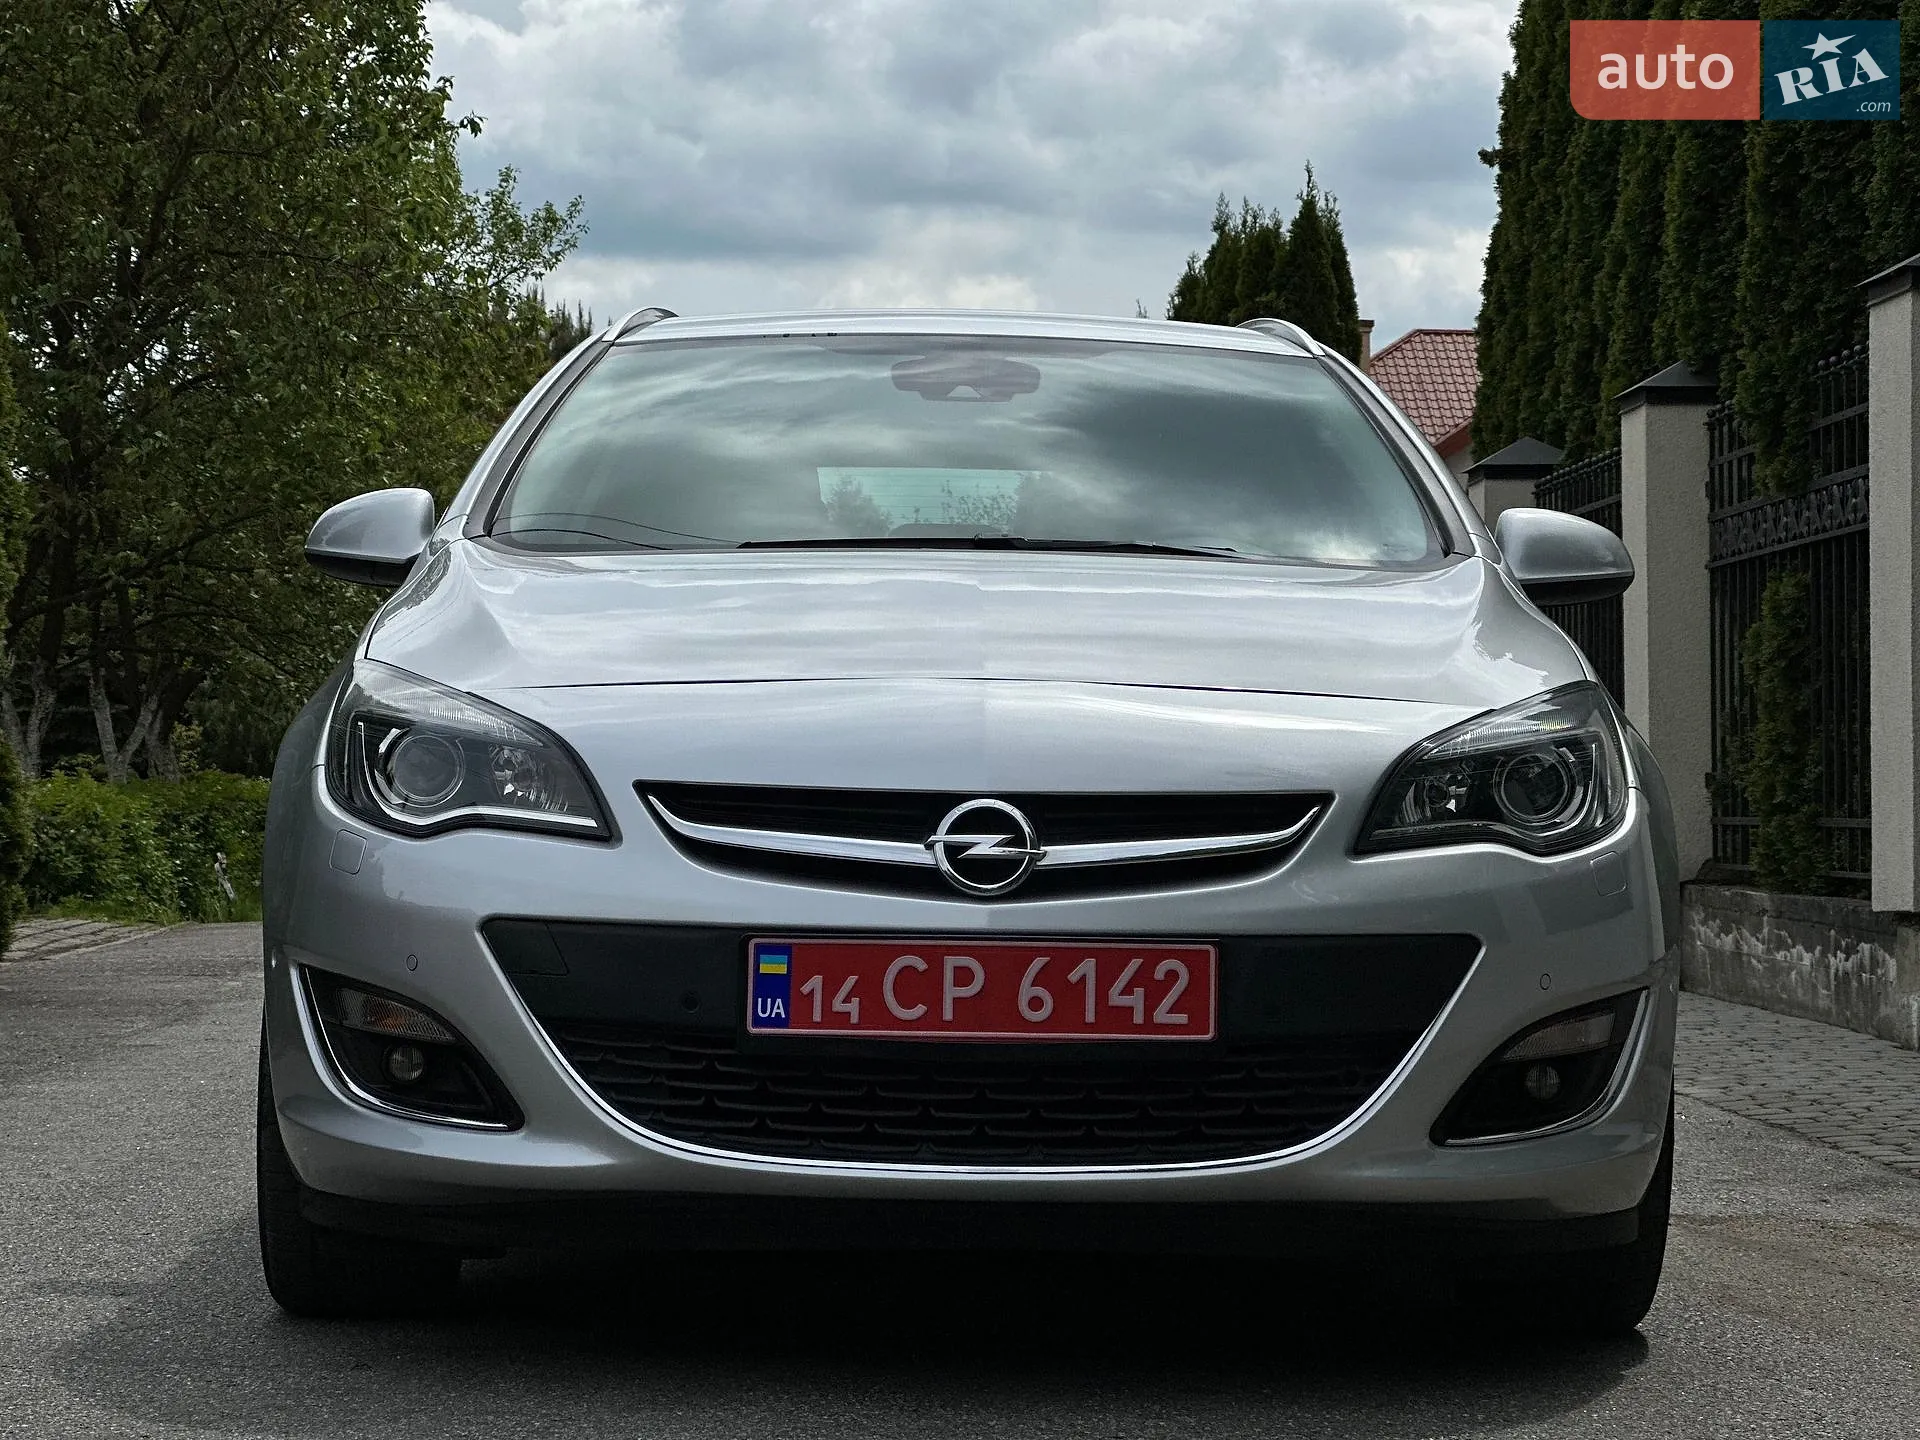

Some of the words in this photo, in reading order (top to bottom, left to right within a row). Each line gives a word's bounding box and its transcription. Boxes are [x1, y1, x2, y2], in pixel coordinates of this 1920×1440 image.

[757, 997, 786, 1019] UA
[800, 975, 860, 1024] 14
[882, 955, 985, 1022] CP
[1017, 957, 1190, 1025] 6142
